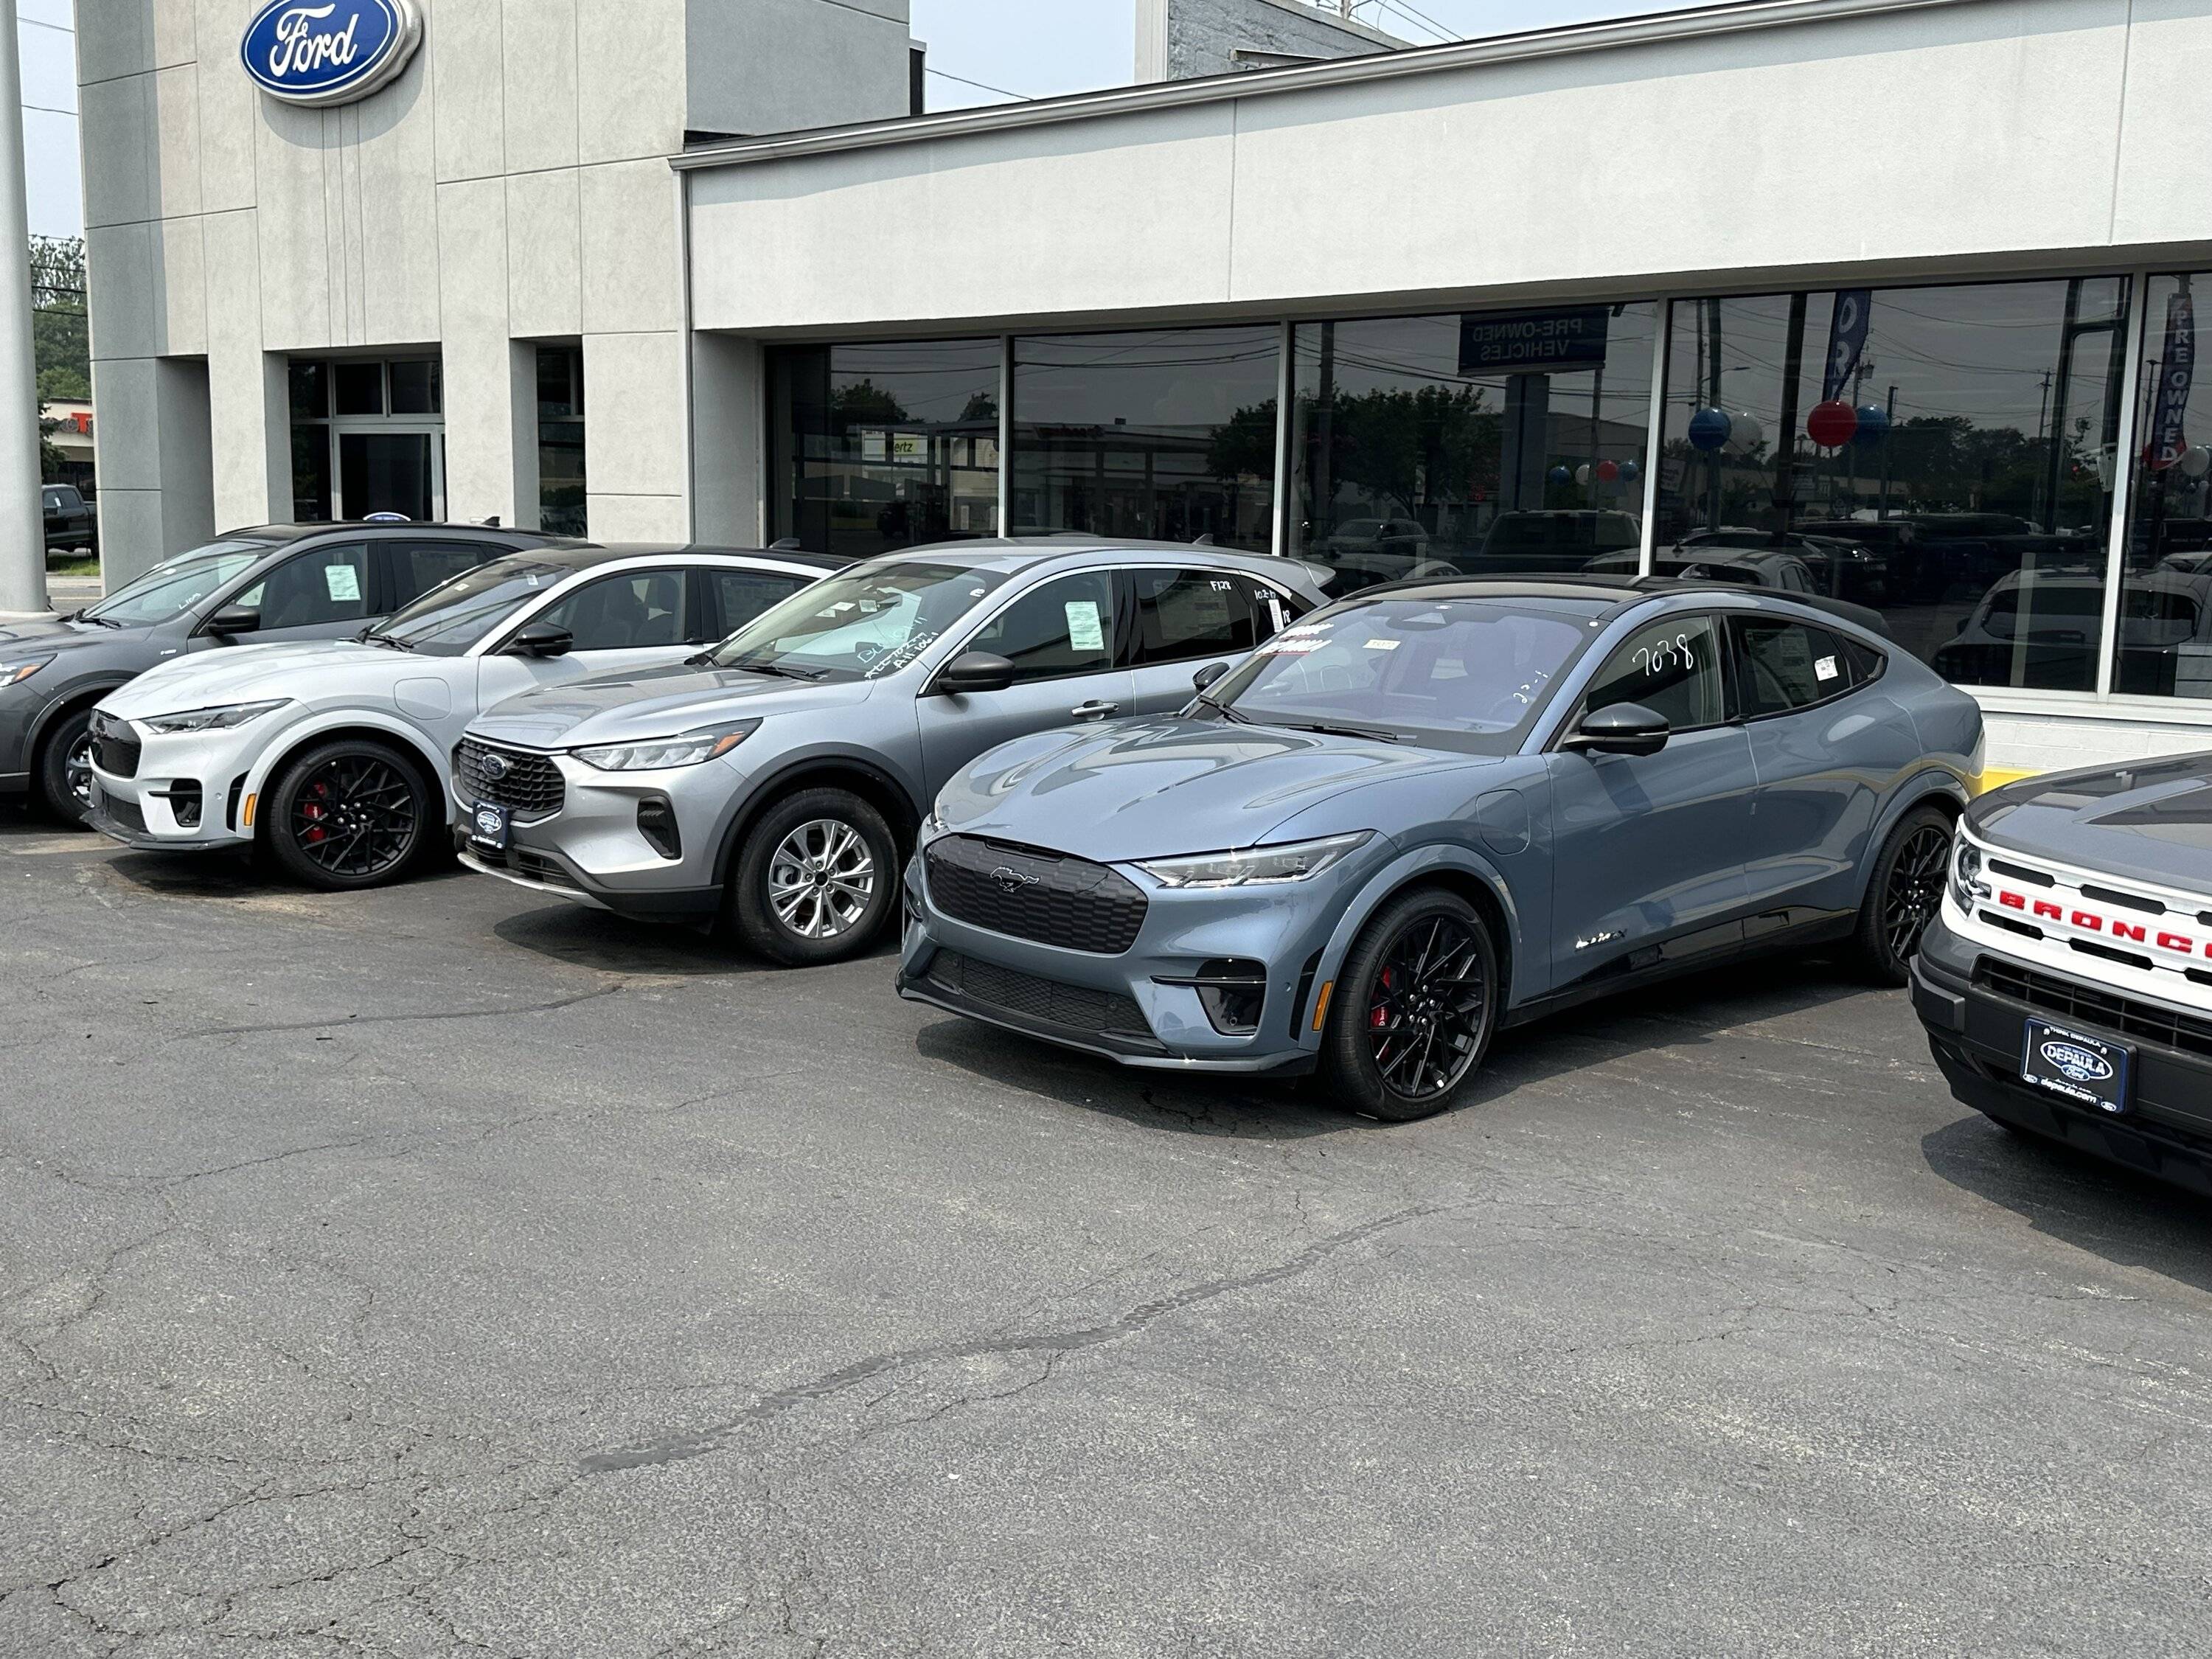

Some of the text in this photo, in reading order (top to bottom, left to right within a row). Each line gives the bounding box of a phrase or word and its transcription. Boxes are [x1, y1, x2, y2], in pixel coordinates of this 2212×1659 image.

[269, 3, 360, 77] Ford
[2161, 372, 2188, 461] OWNED
[894, 442, 913, 453] ertz
[1999, 889, 2212, 959] BRONC
[2046, 1044, 2106, 1075] DEPAULA
[2040, 1078, 2098, 1104] depaula.com
